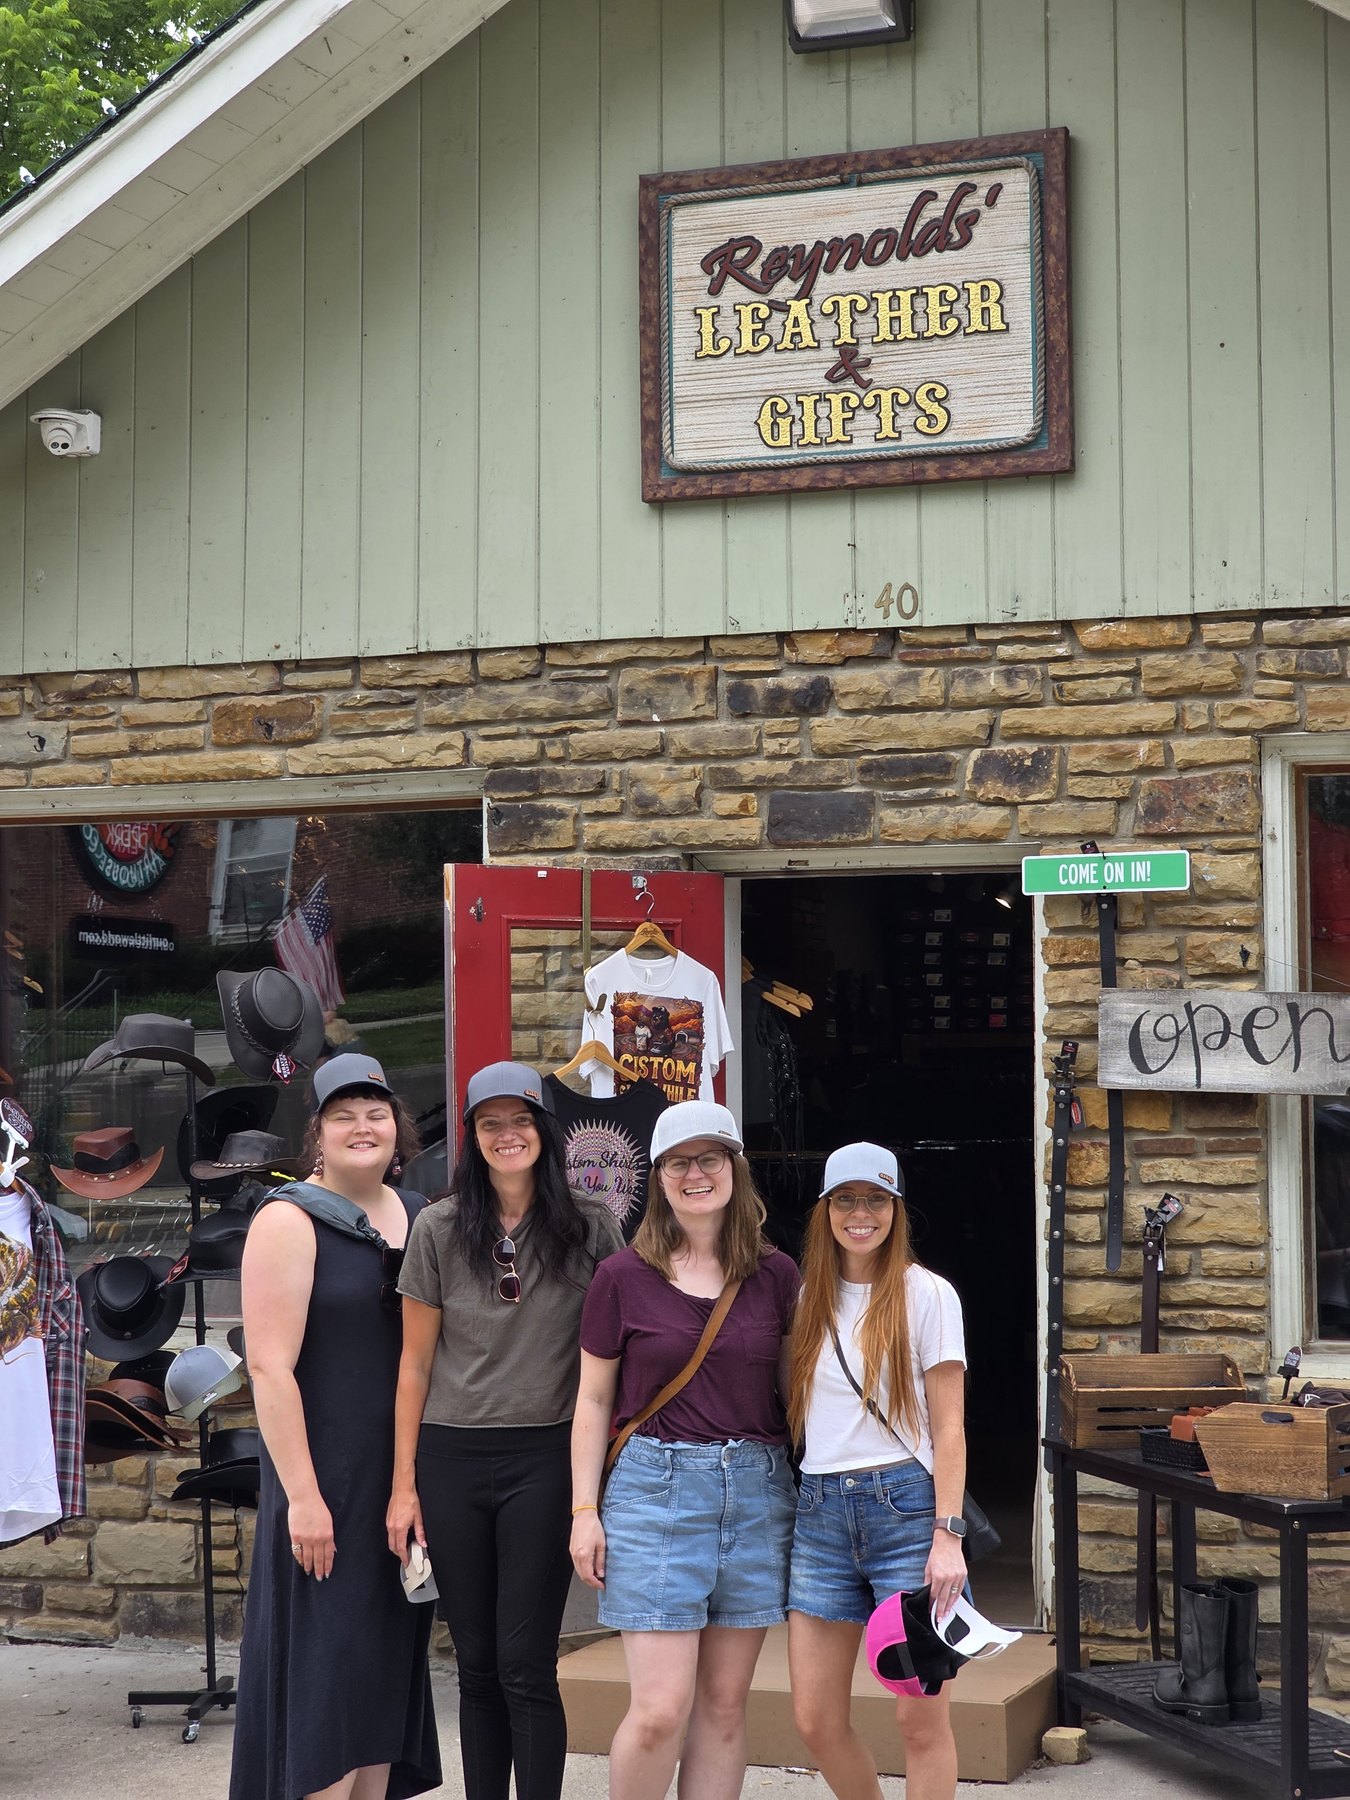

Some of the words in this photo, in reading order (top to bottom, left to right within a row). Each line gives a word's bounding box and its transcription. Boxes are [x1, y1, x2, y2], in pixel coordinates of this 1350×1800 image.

[695, 278, 1009, 359] LEATHER
[824, 347, 872, 388] &
[755, 381, 951, 448] GIFTS
[874, 582, 919, 620] 40
[1059, 863, 1099, 886] COME
[1103, 862, 1125, 884] ON
[1131, 860, 1151, 883] IN!
[584, 1175, 612, 1196] You
